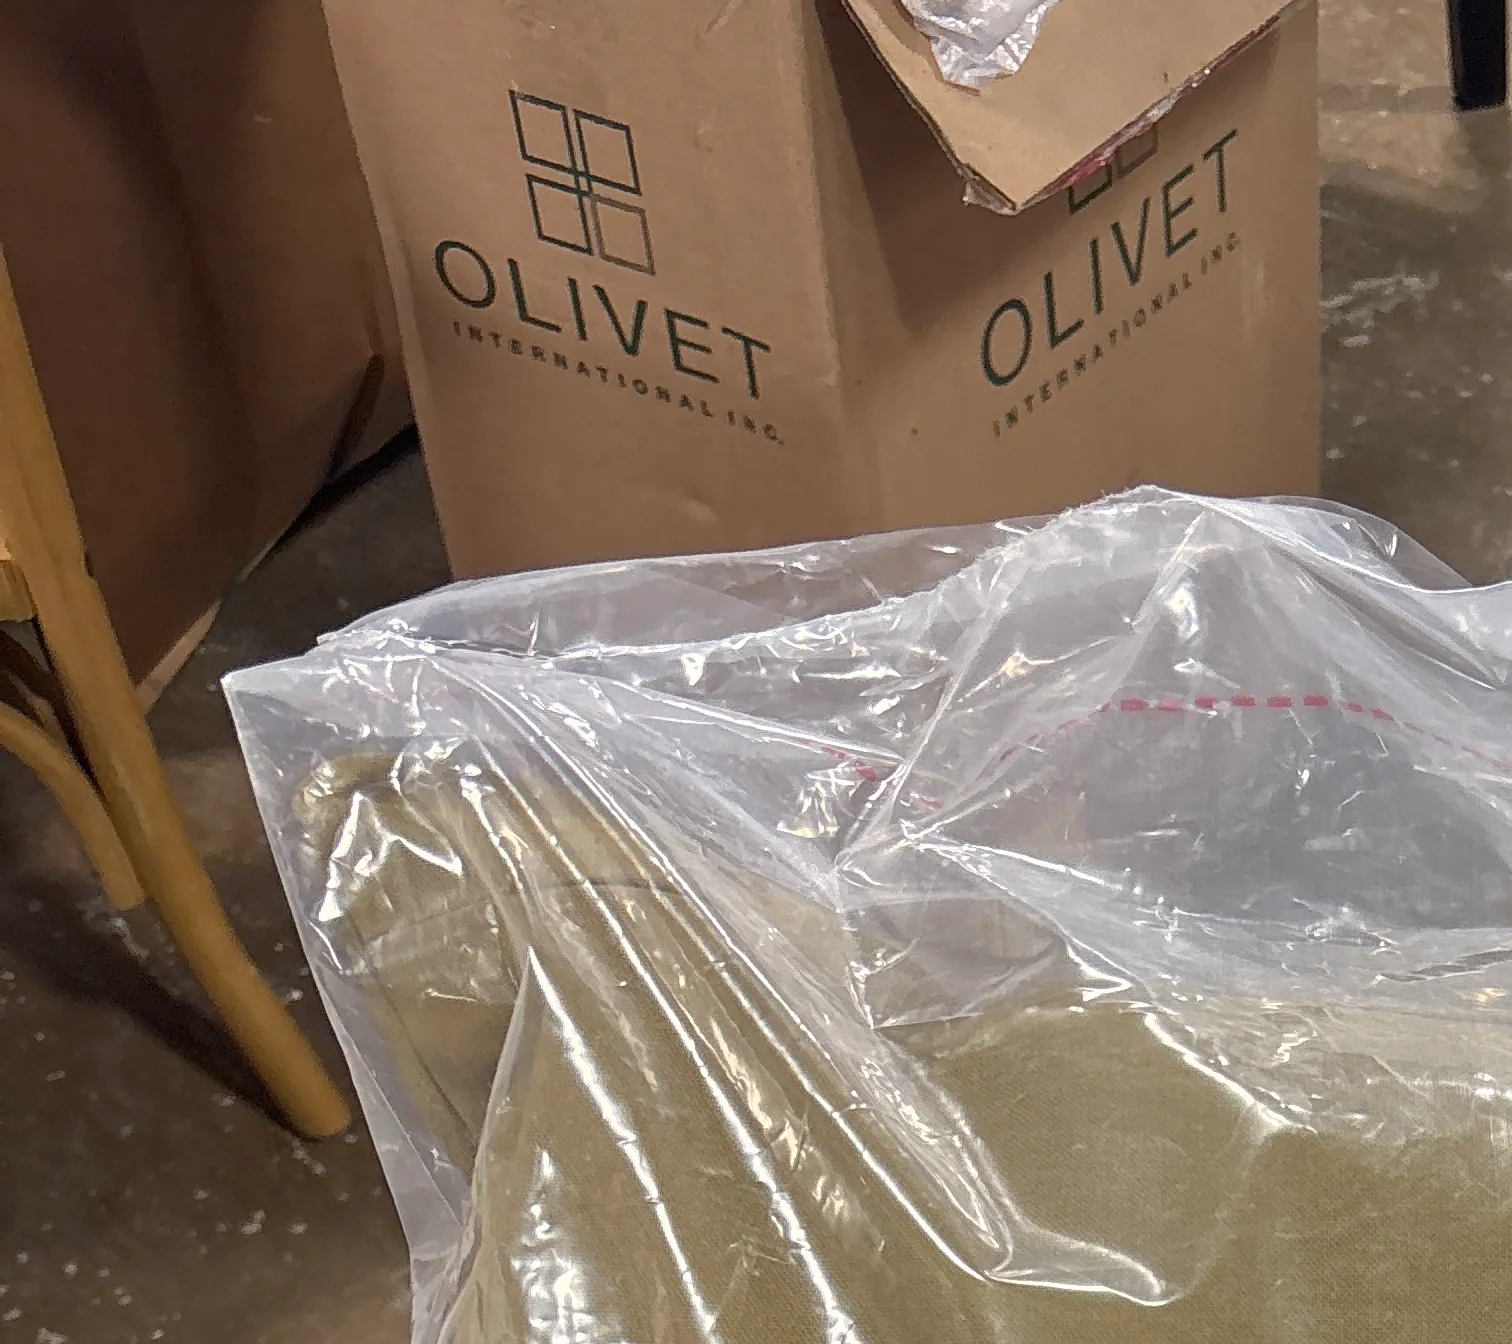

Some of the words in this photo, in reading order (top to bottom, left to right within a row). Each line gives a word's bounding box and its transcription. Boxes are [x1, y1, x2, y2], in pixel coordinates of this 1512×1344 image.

[434, 240, 772, 400] OLIVET
[980, 128, 1238, 387] OLIVET
[452, 321, 716, 418] INTERNATIONAL
[992, 272, 1193, 438] INTERNATIONAL
